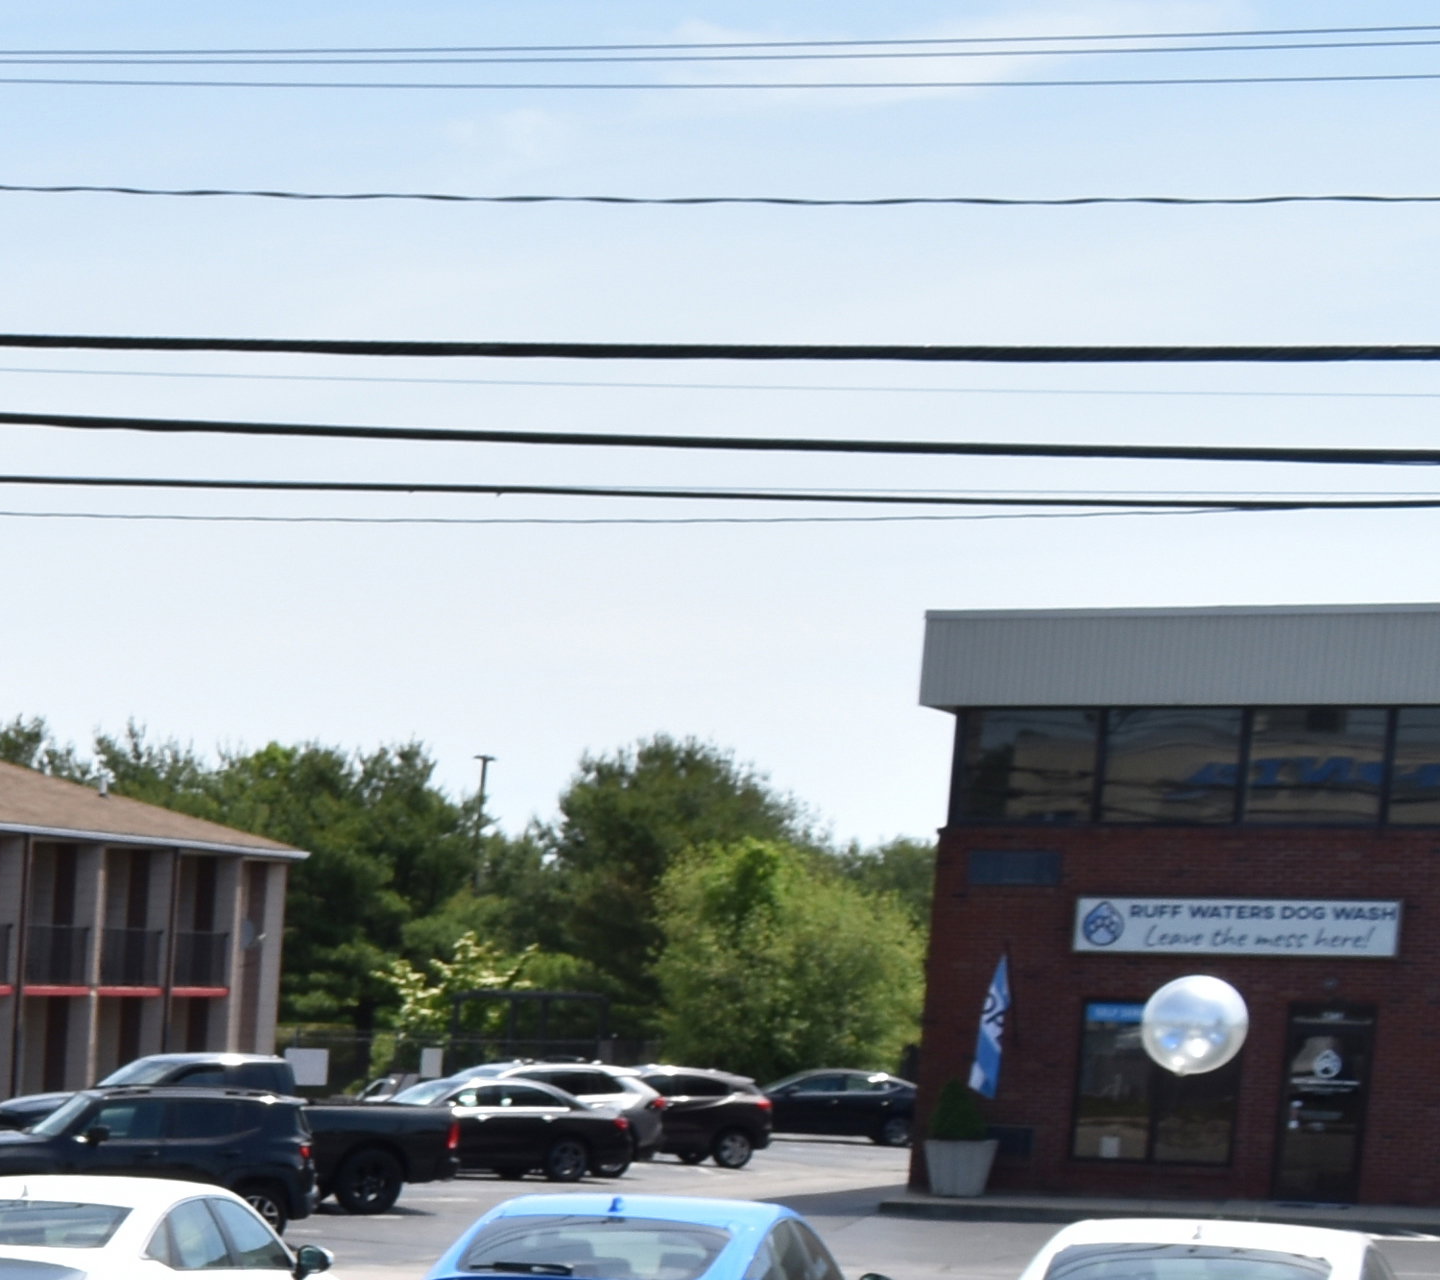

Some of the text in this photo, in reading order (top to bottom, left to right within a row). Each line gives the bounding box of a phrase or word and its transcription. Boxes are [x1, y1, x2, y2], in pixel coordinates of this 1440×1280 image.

[1130, 904, 1397, 921] RUFF WATERS DOG WASH
[1143, 924, 1376, 949] Leave the mess here!
